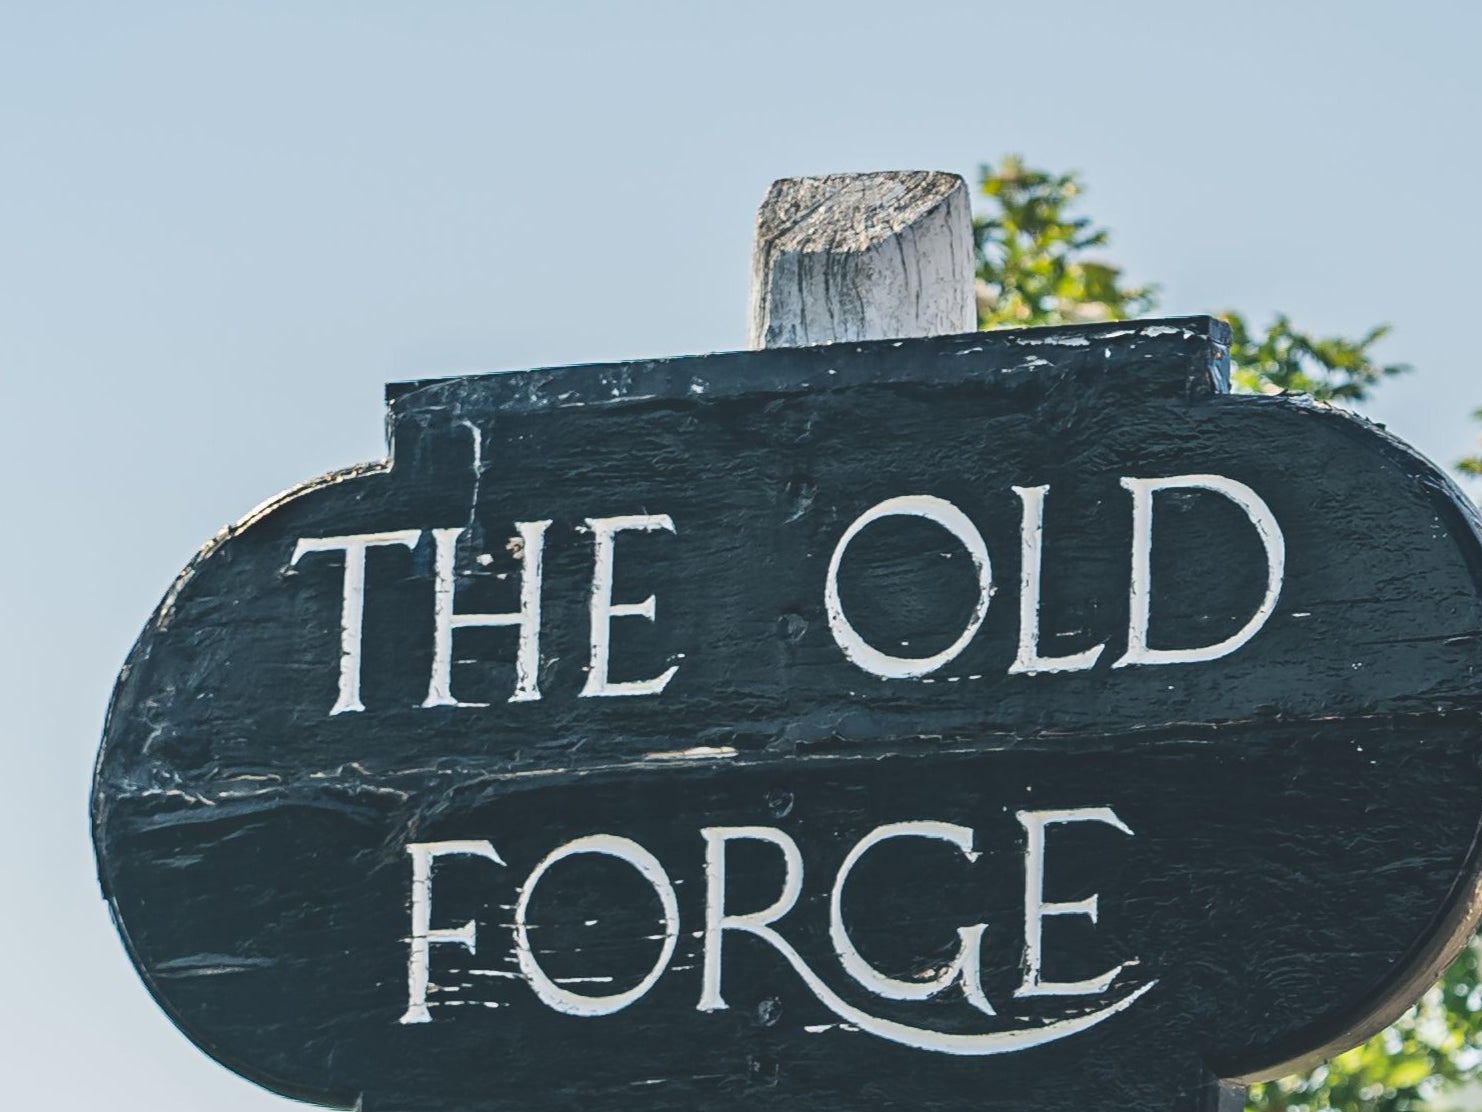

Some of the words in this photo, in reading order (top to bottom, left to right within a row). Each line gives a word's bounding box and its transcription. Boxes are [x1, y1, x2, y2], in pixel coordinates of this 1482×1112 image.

[291, 514, 678, 715] THE
[825, 474, 1284, 680] OLD
[400, 808, 1154, 1055] FORGE
